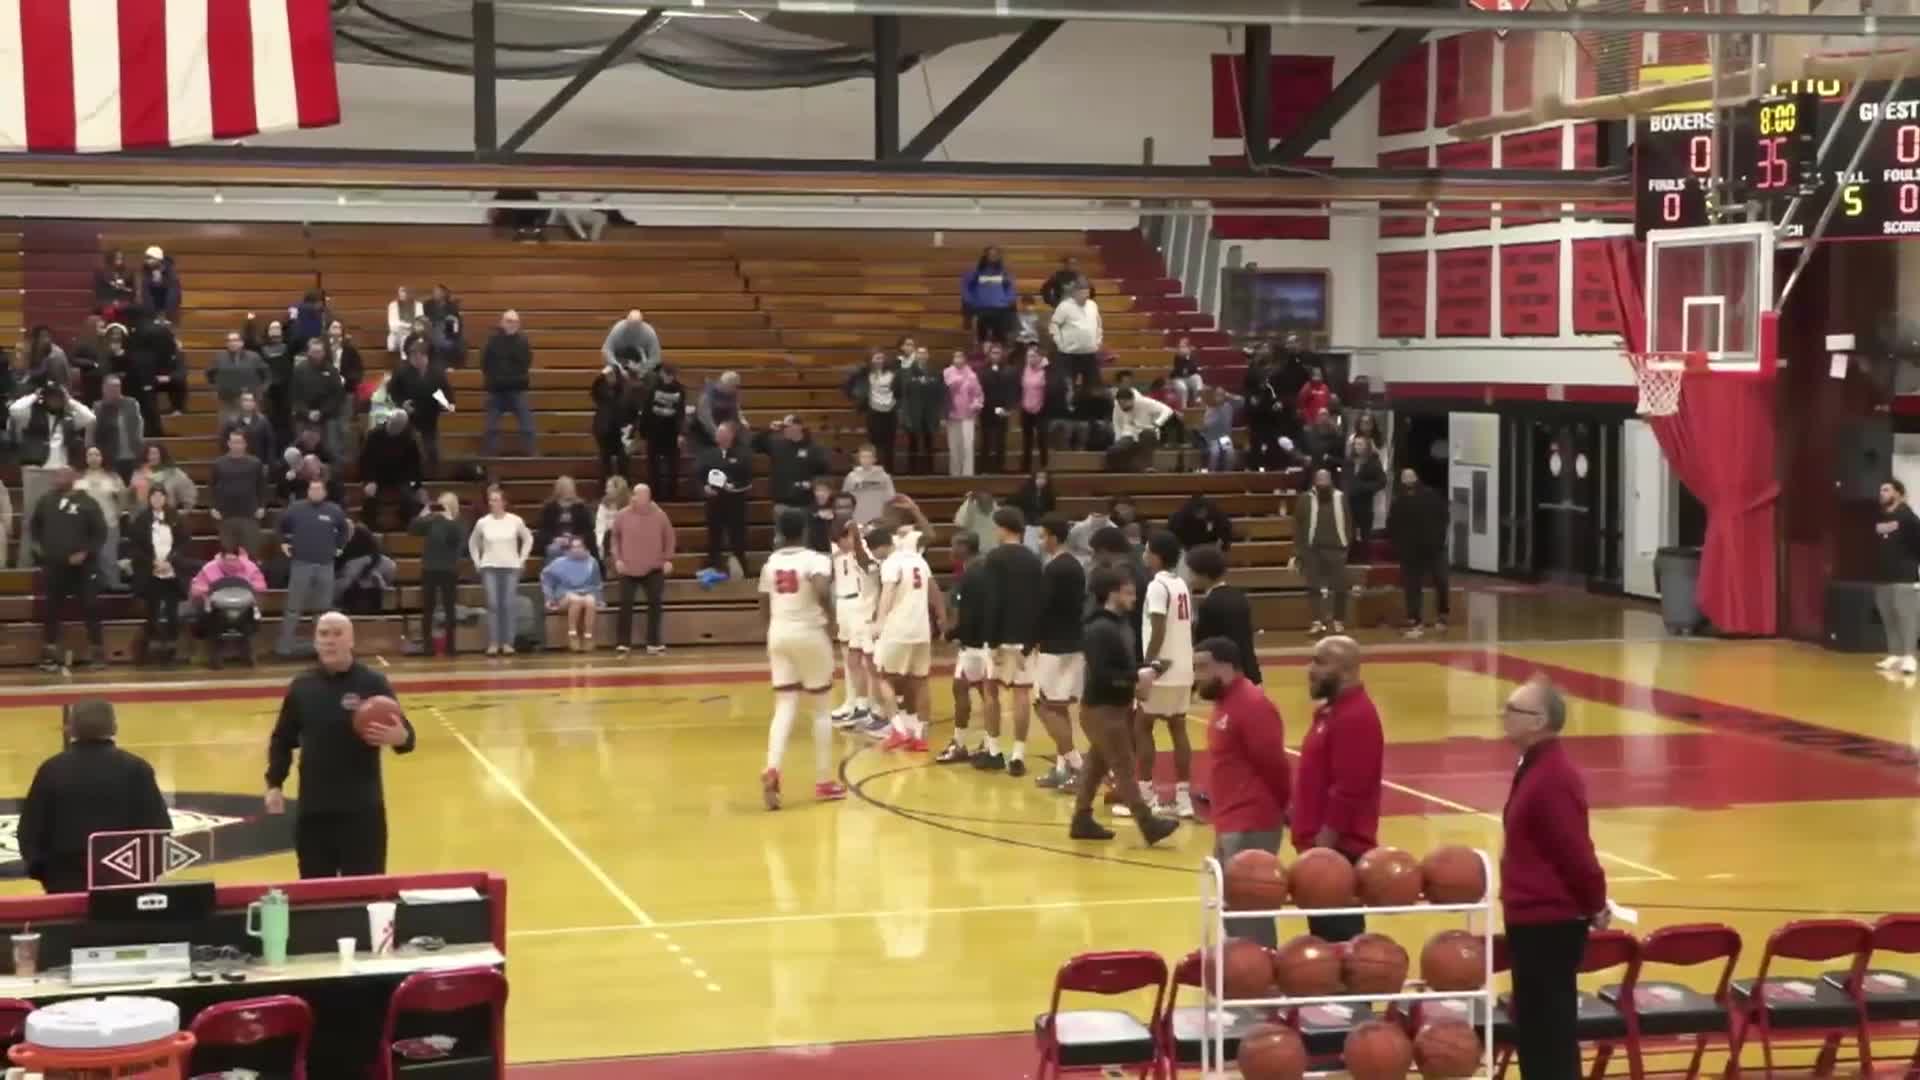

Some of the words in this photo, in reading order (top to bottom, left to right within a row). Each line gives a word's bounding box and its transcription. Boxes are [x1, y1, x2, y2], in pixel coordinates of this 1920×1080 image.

[1650, 112, 1715, 132] BOXERS
[1760, 103, 1796, 134] 8:00
[1690, 135, 1711, 172] 0
[1897, 125, 1920, 162] 0
[1757, 137, 1788, 188] 35
[1664, 193, 1680, 221] 0
[1843, 186, 1862, 215] 5
[1899, 183, 1919, 213] 0
